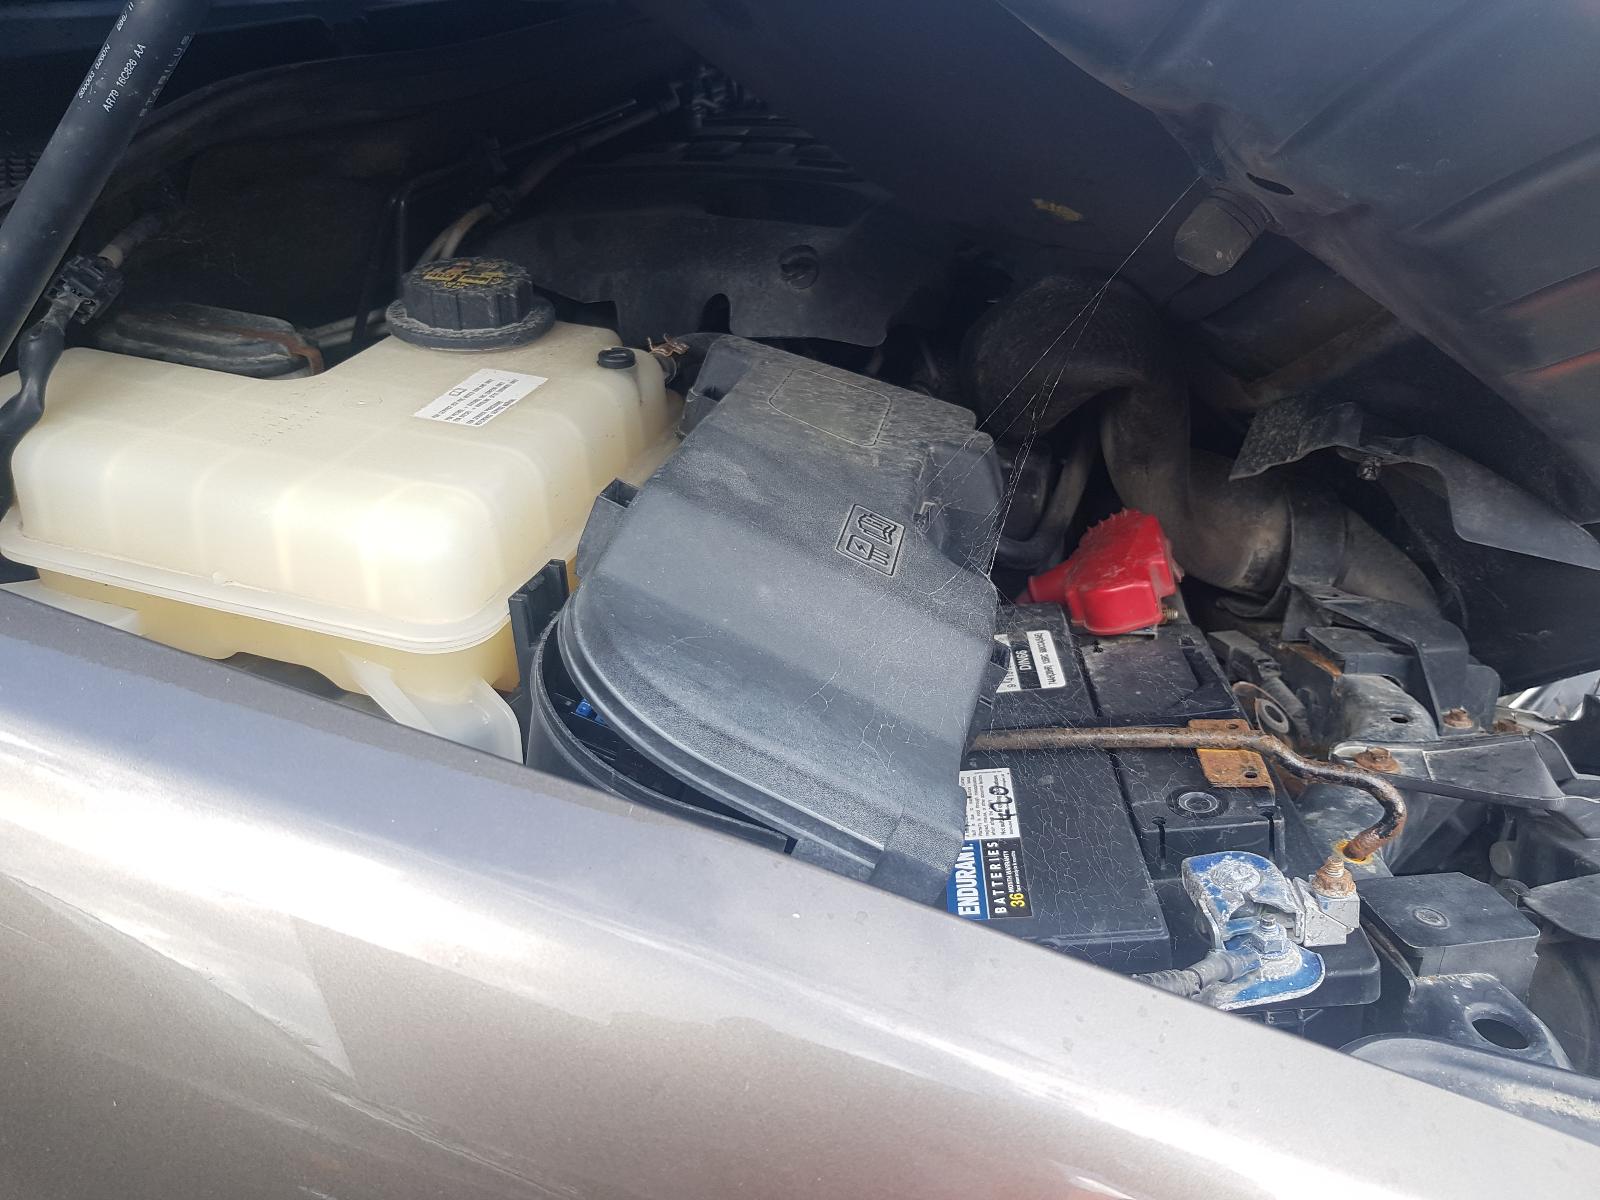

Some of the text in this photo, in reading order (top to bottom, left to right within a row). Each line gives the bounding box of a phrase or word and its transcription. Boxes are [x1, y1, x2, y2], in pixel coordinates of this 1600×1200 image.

[102, 43, 147, 113] AR79 16C826 AA
[1015, 649, 1032, 671] DIN66
[987, 841, 1008, 914] BATTERIES
[1009, 892, 1026, 908] 36
